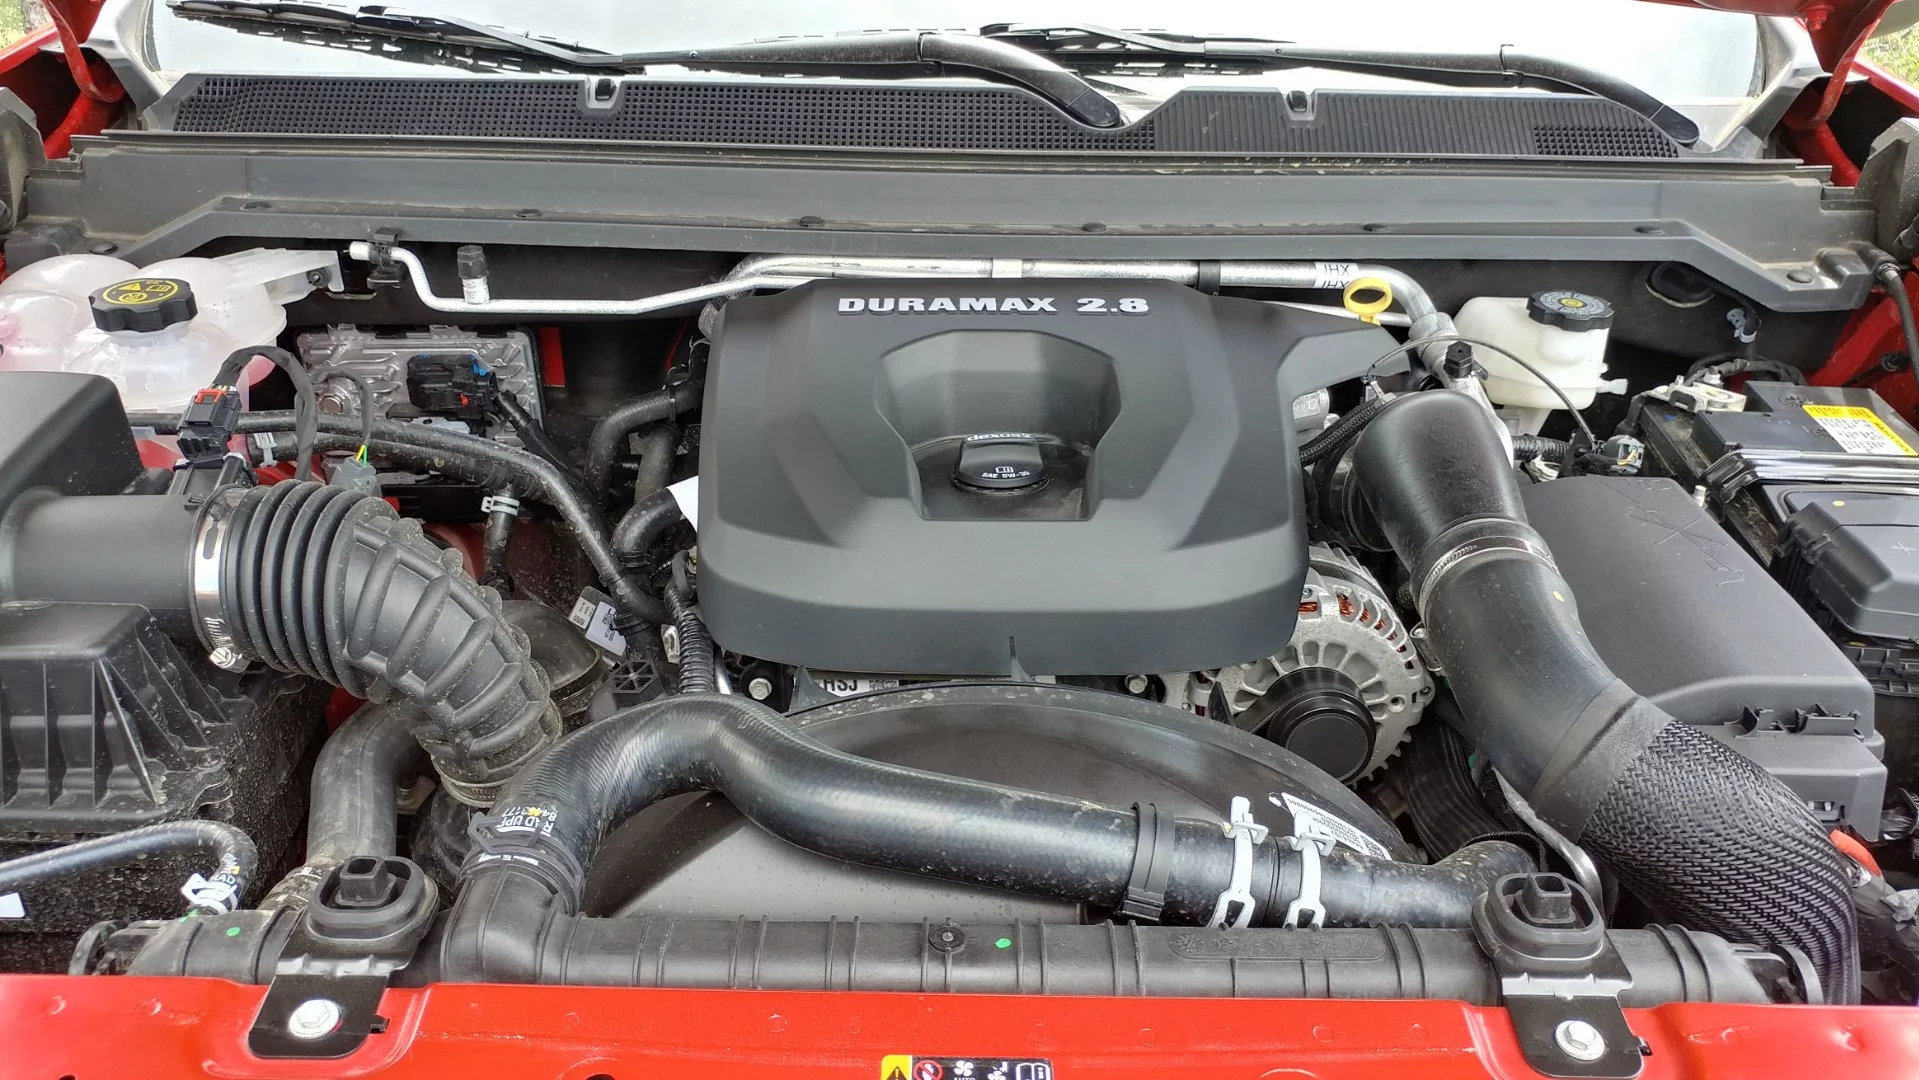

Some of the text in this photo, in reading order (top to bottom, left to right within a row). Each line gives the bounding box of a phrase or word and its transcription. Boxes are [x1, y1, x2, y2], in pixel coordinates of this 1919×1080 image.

[838, 297, 1149, 315] DURAMAX 2.8
[501, 806, 558, 822] 843177
